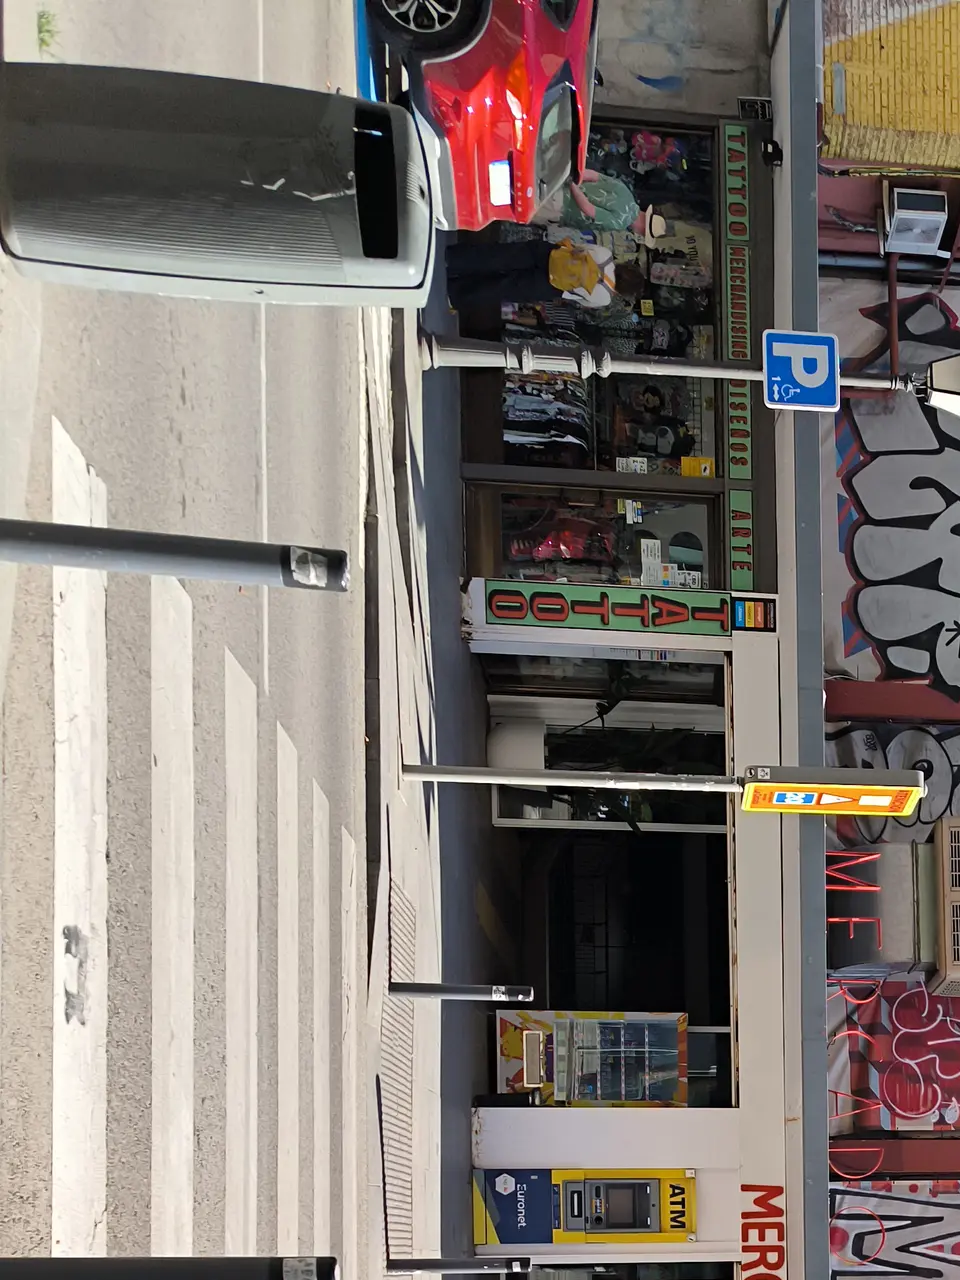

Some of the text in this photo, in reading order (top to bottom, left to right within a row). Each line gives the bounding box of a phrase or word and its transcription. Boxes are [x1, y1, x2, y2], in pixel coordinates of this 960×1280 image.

[727, 132, 752, 572] TATTOO MERCHANDISING DISEÑOS ARTE
[772, 342, 829, 388] P
[487, 589, 729, 632] TATTOO
[516, 1184, 527, 1228] Euronet
[669, 1183, 686, 1230] ATM
